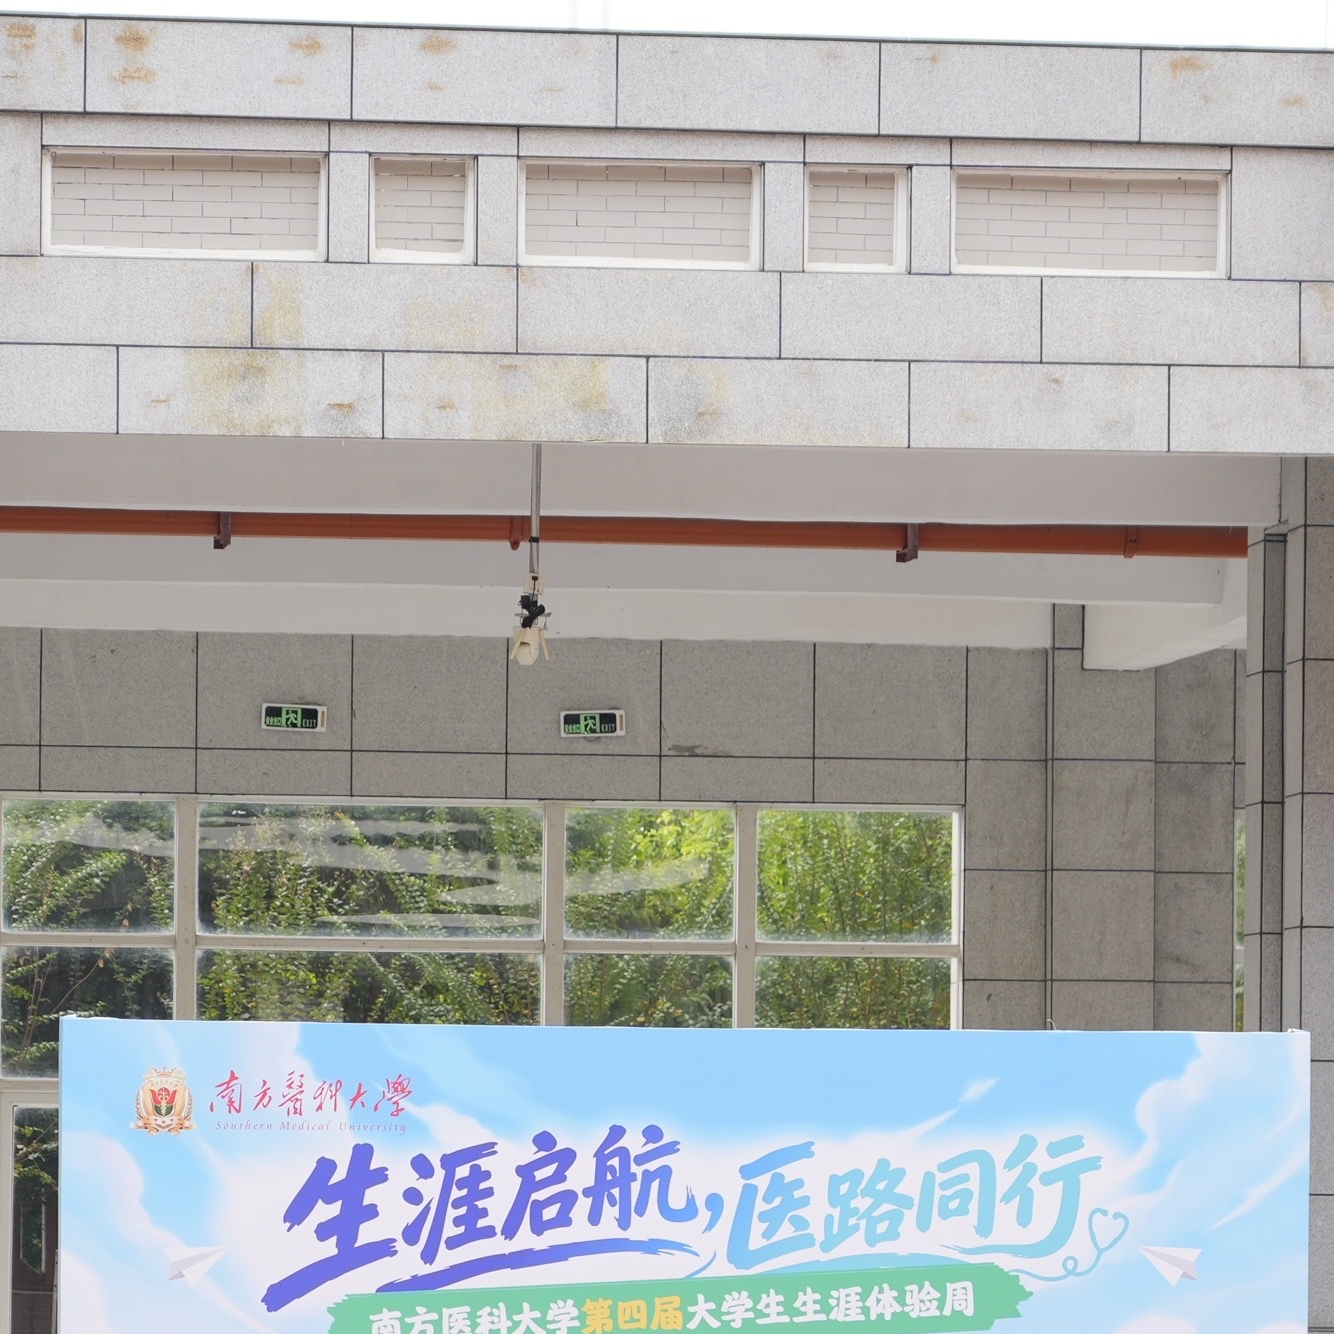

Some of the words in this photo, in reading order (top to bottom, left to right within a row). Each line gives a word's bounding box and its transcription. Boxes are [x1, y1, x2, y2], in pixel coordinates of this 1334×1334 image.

[302, 719, 317, 728] EXIT
[601, 723, 616, 732] EXIT
[216, 1120, 273, 1131] Southern
[279, 1120, 330, 1131] Medical
[339, 1120, 408, 1136] University
